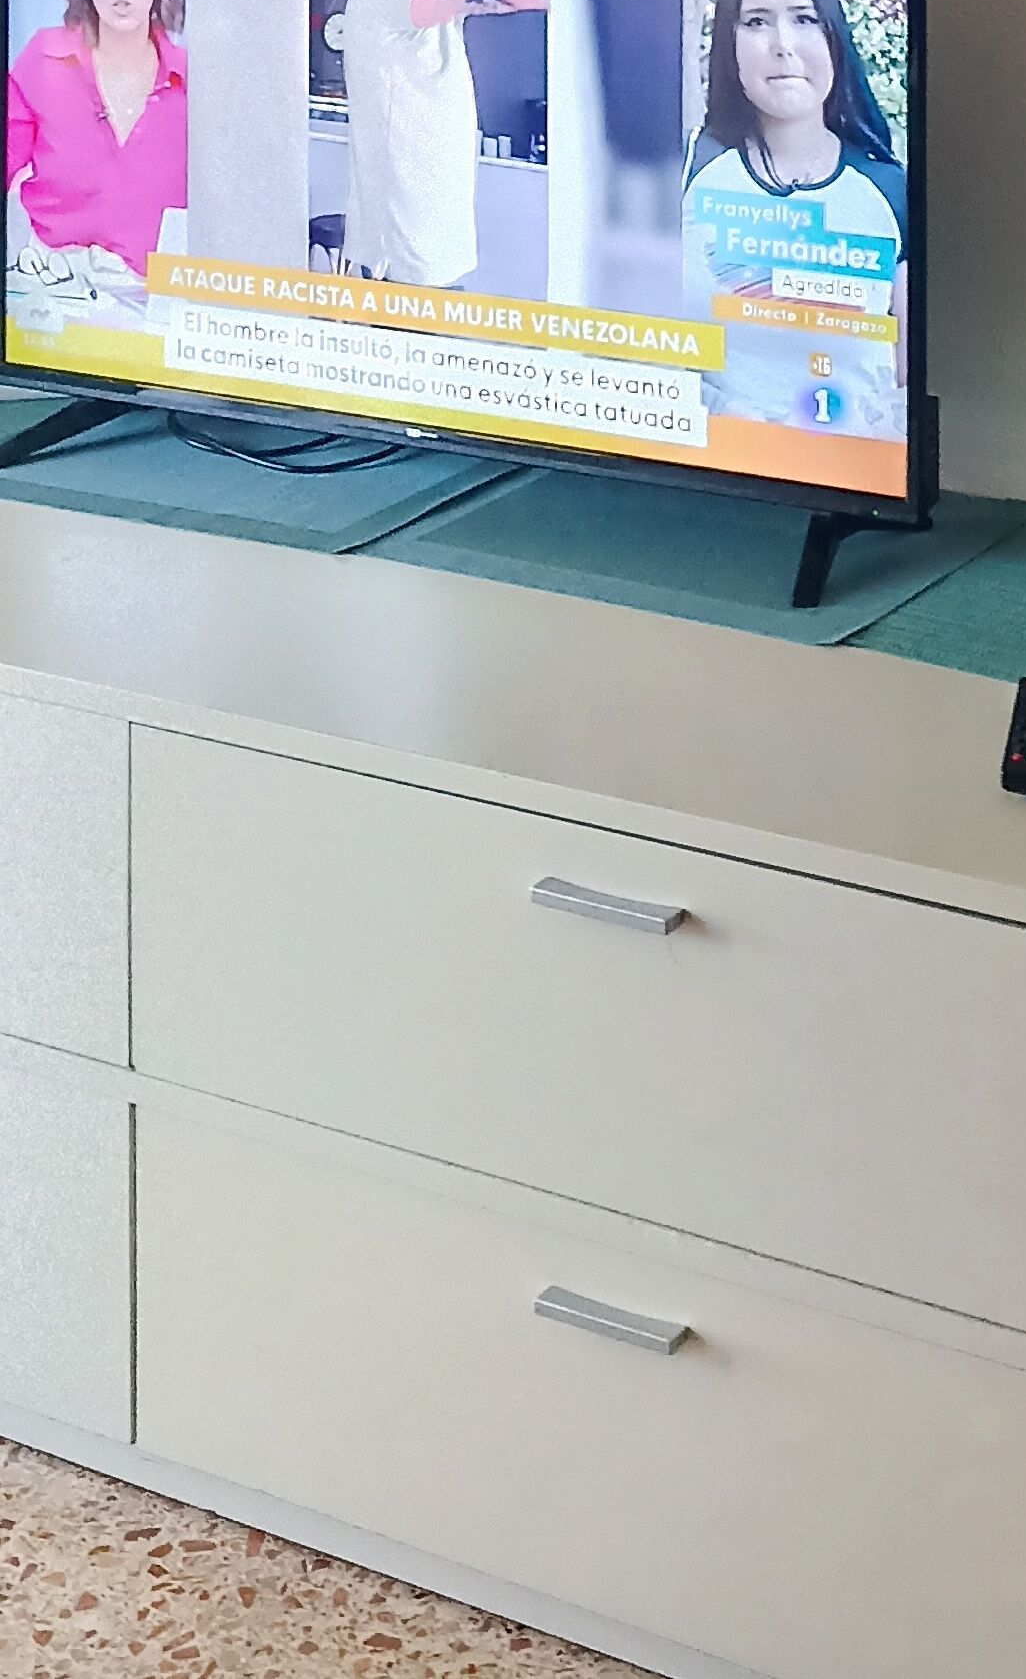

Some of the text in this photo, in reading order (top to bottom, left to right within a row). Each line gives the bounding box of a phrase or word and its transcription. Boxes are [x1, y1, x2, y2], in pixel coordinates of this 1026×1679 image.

[702, 195, 812, 230] Franyellys
[726, 227, 882, 271] Fernández
[169, 266, 700, 356] ATAQUE RACISTA A UNA MUJER VENEZOLANA
[742, 302, 887, 335] Directo Zaragoza
[183, 311, 680, 400] El hombre la insultó, la amenazó y se levantó
[177, 338, 692, 432] la camiseta mostrando una esvástica tatuada
[814, 388, 831, 423] 1
